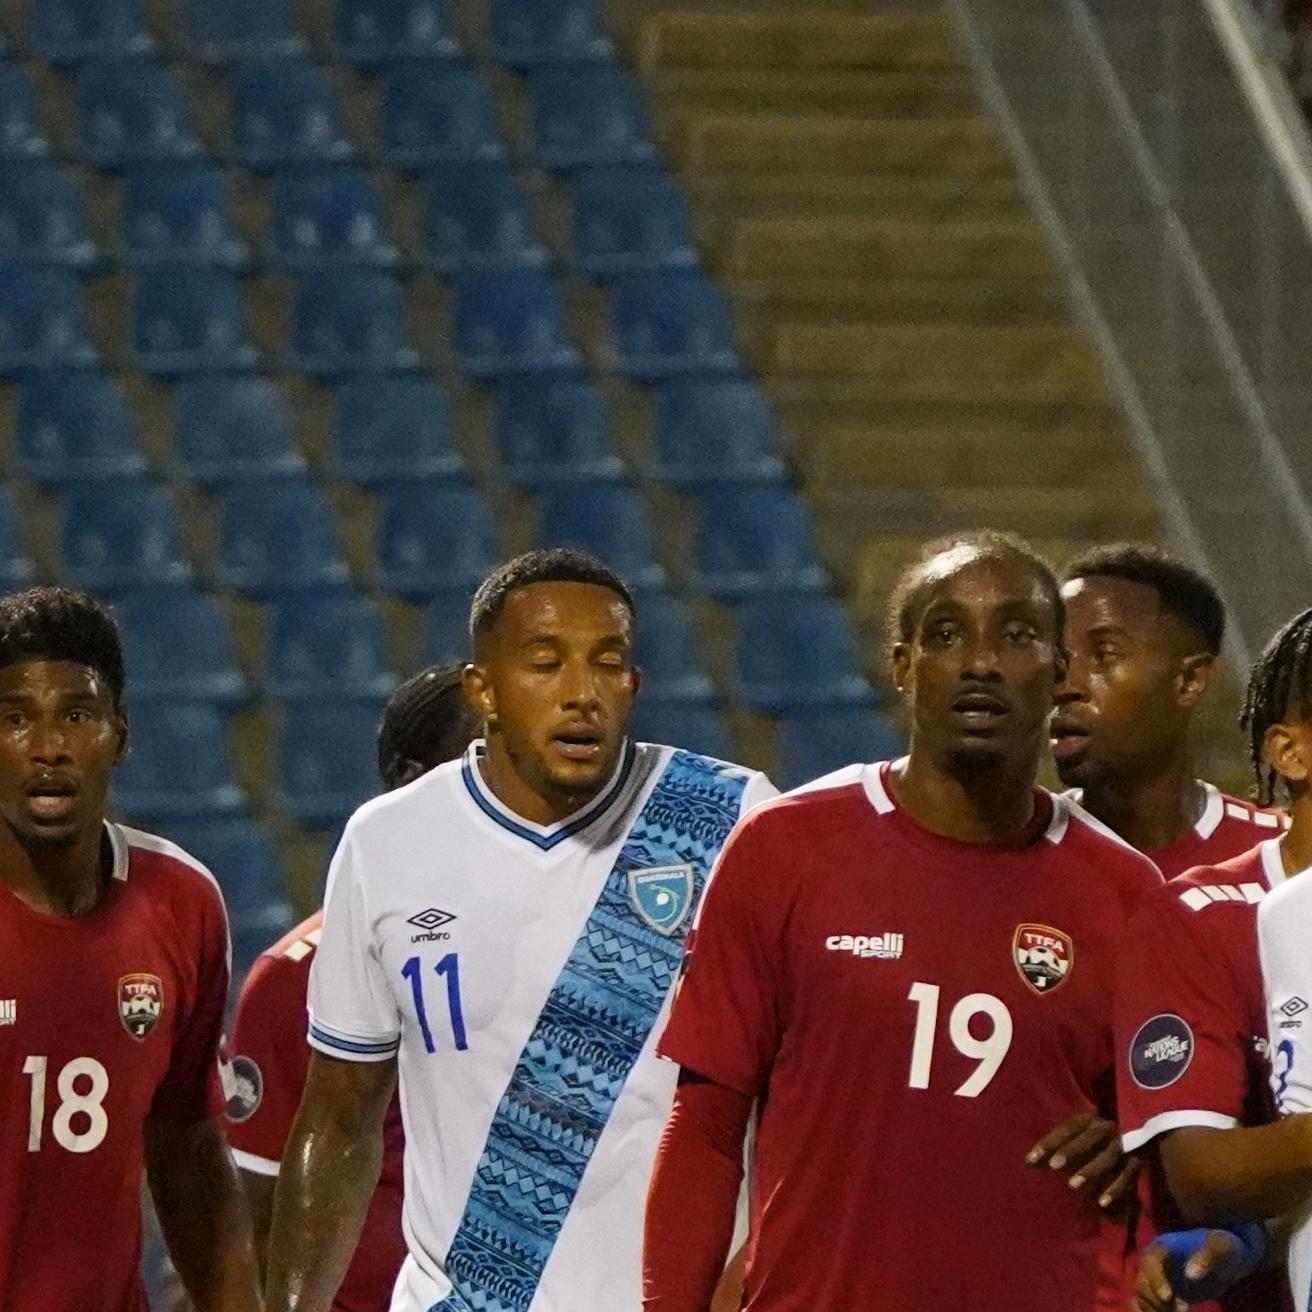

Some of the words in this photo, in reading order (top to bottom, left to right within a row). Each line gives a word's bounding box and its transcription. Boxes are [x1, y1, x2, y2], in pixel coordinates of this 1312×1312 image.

[411, 929, 451, 943] umbro
[826, 932, 904, 954] capelli
[1024, 932, 1065, 953] TTFA
[861, 950, 903, 960] SPORT
[124, 983, 158, 996] TTFA
[401, 953, 469, 1054] 11
[907, 981, 1014, 1098] 19
[21, 1055, 110, 1154] 18
